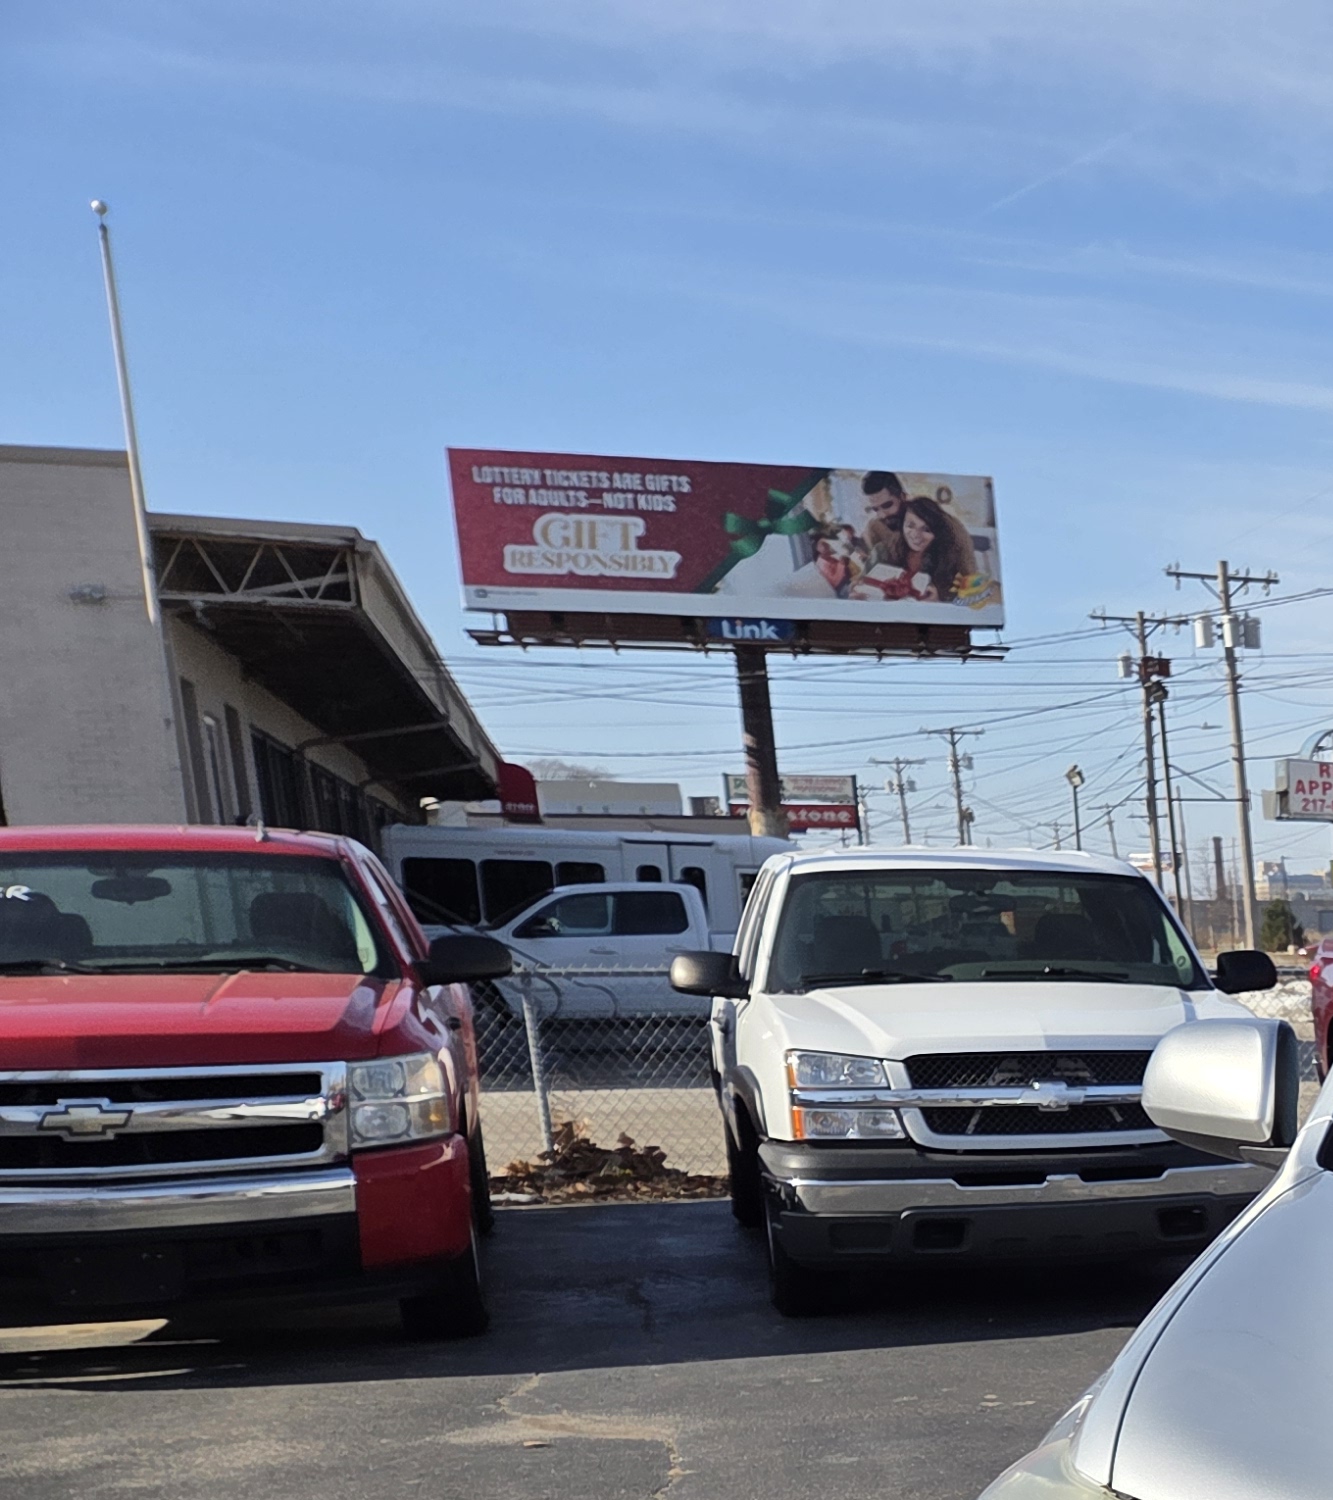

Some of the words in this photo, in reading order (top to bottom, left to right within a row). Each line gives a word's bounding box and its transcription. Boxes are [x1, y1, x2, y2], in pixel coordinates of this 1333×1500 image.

[472, 466, 541, 485] LOTTERY
[543, 469, 611, 489] TICKETS
[612, 472, 645, 490] ARE
[645, 473, 692, 493] GIFTS
[493, 486, 526, 505] FOR
[637, 493, 677, 512] KIDS
[540, 518, 640, 551] GIFT
[510, 550, 677, 574] RESPONSIBLY
[722, 620, 781, 640] Link
[0, 884, 32, 901] R
